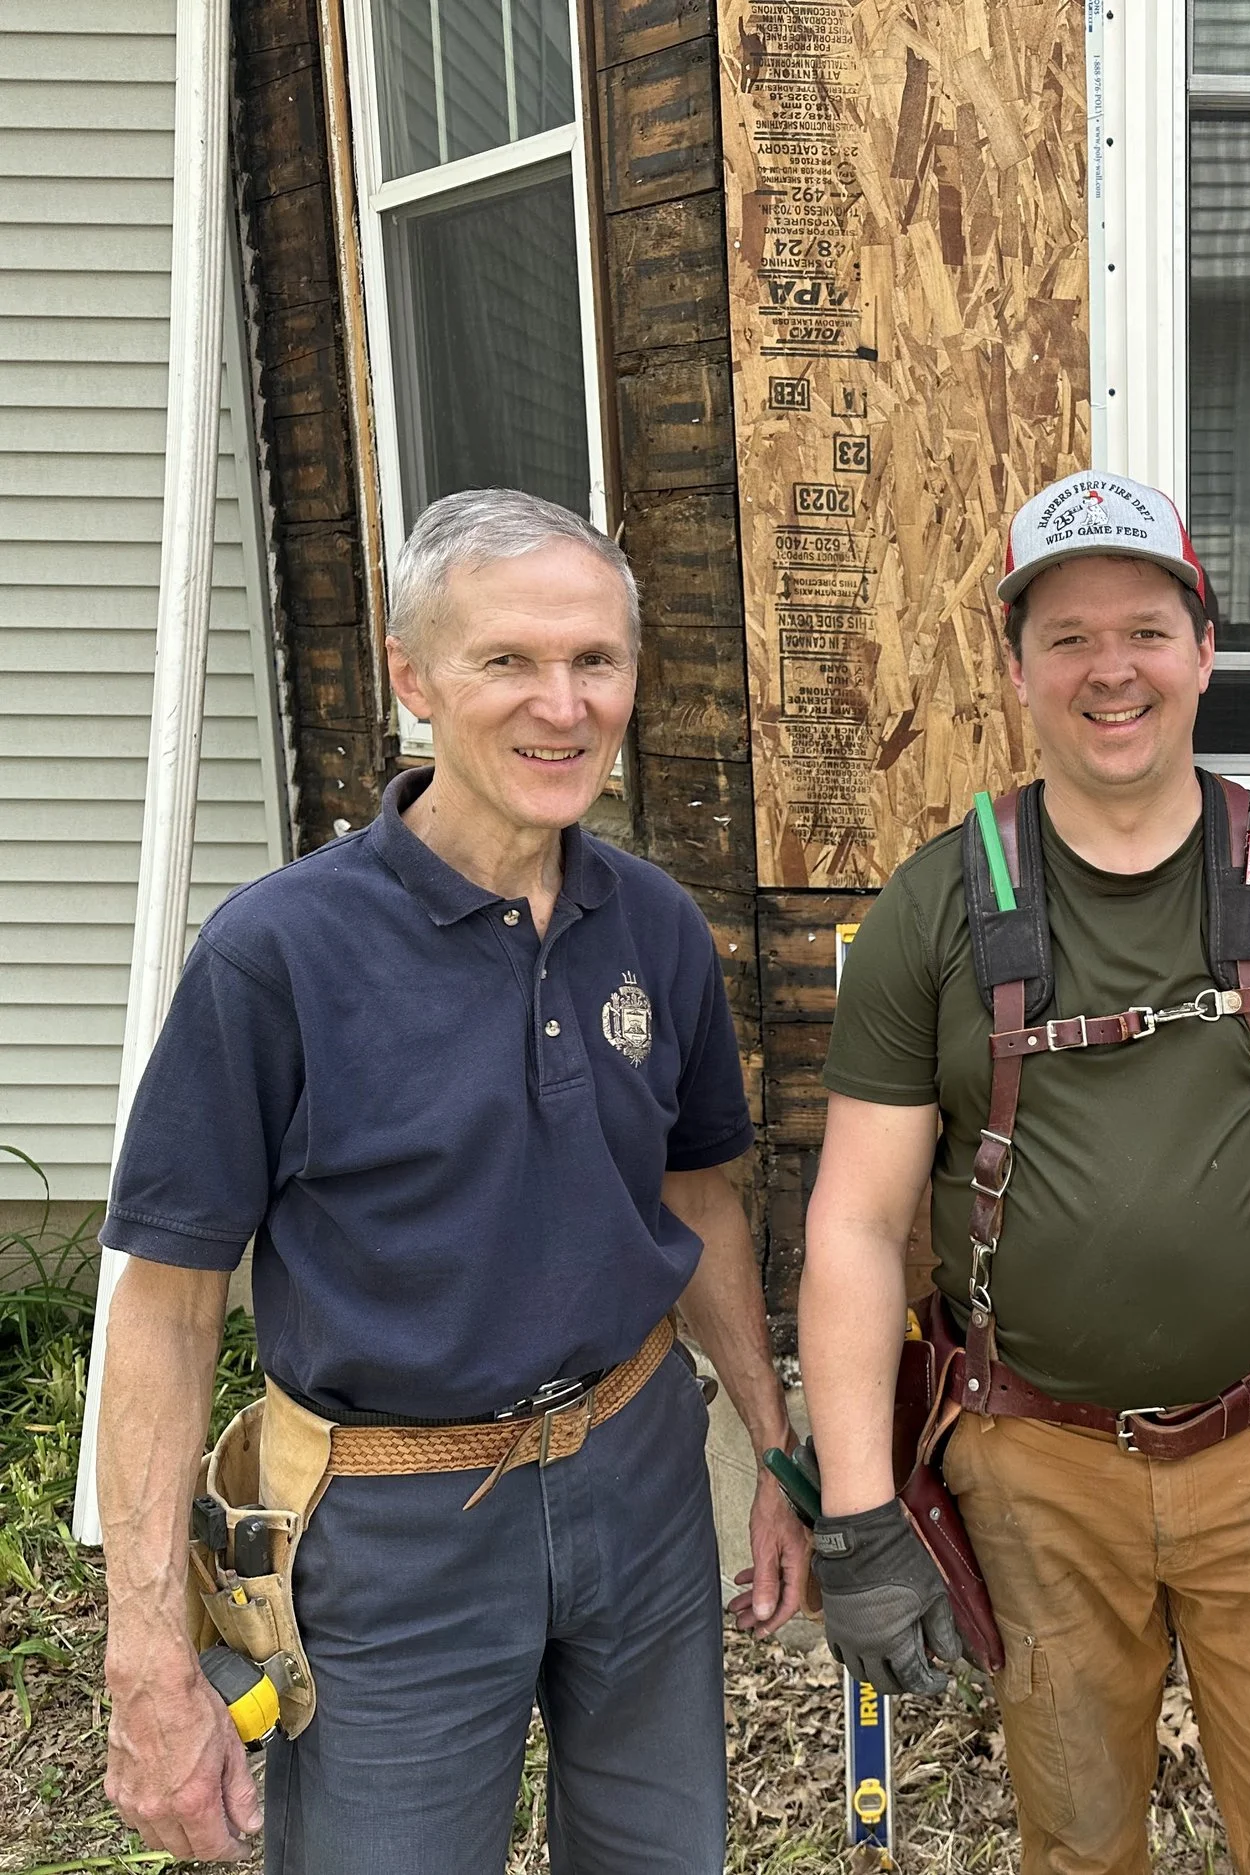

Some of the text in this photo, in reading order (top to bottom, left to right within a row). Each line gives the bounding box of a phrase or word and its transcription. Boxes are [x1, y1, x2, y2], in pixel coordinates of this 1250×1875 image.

[751, 5, 835, 16] RECOMMENDATIONS
[790, 34, 853, 44] PERFORMANCE
[777, 42, 831, 52] FOR PROPER
[768, 68, 840, 80] ATTENTION:
[754, 84, 794, 92] ADHESIVE
[795, 85, 816, 93] TYPE
[781, 102, 802, 110] mm
[756, 120, 798, 131] SHEATHING
[757, 143, 818, 156] CATEGORY
[1093, 126, 1103, 199] www.poly-wall.com
[760, 176, 802, 184] SHEATHING
[791, 186, 826, 203] 492
[774, 217, 844, 228] EXPOSURE 1
[764, 226, 856, 236] SIZED FOR SPACING
[760, 258, 822, 269] SHEATHING
[767, 280, 849, 306] APA
[790, 318, 813, 326] LAKE
[814, 319, 853, 328] MEADOW
[776, 326, 842, 346] TOLKO
[773, 382, 806, 406] FEB
[842, 387, 856, 412] A
[838, 441, 866, 466] 23
[799, 487, 850, 513] 2023
[1036, 480, 1155, 530] HARPERS FERRY FIRE DEPT
[1045, 525, 1148, 545] WILD GAME FEED
[793, 578, 857, 588] THIS DIRECTION
[794, 588, 857, 597] STRENGTH AXIS
[778, 614, 875, 630] THIS SIDE DOWN
[785, 636, 826, 648] CANADA
[828, 637, 840, 648] IN
[820, 664, 848, 672] CARB
[826, 676, 848, 684] HUD
[792, 747, 867, 756] RECOMMENDED
[860, 1682, 878, 1726] IRW
